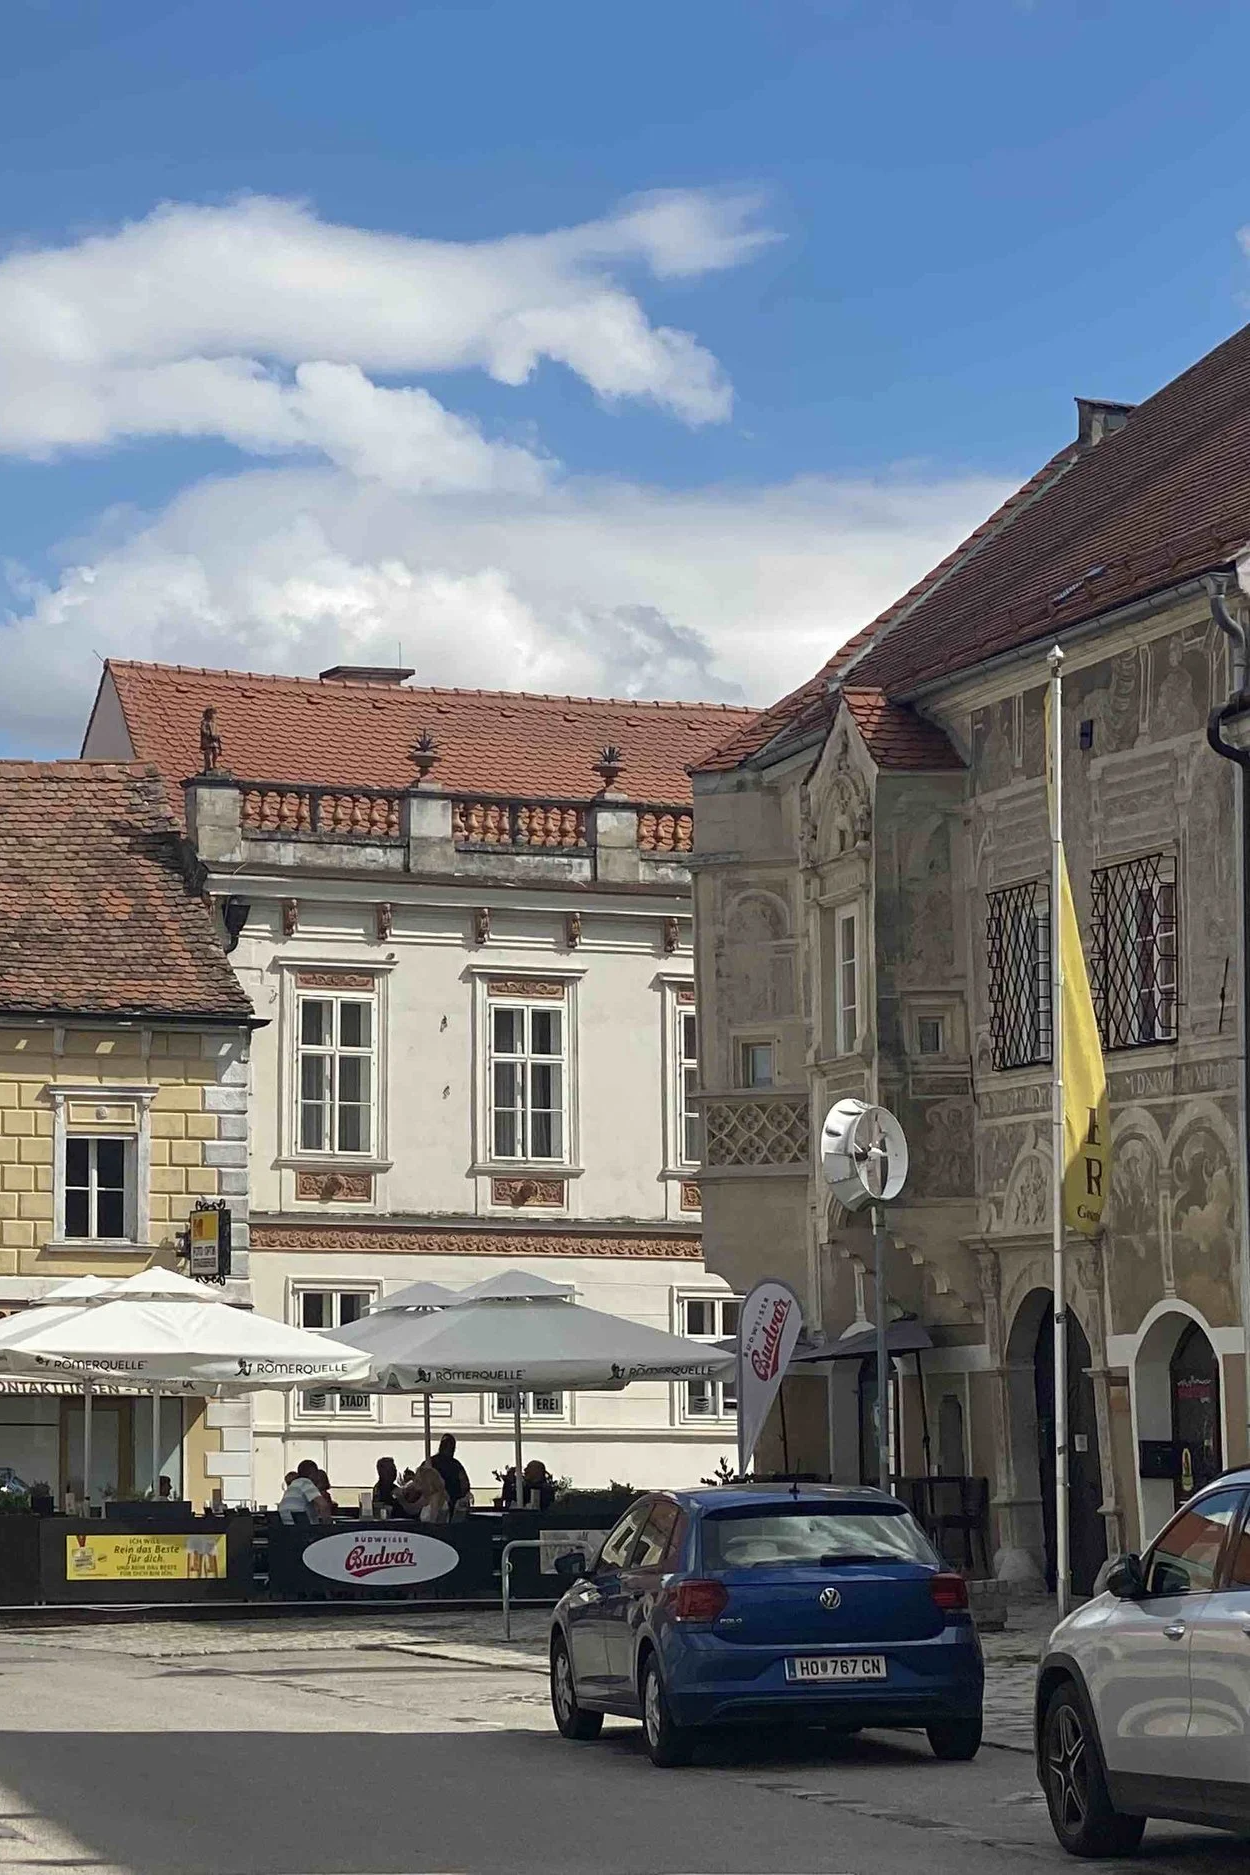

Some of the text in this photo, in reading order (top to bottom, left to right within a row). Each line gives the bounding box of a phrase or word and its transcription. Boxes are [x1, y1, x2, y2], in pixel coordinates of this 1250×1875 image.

[744, 1297, 769, 1358] BUDWEISER
[752, 1299, 791, 1381] Budvar
[340, 1394, 369, 1408] STADT
[114, 1545, 180, 1553] Rein das Beste
[127, 1554, 141, 1564] für
[345, 1545, 417, 1577] Budvar
[800, 1660, 819, 1676] HO
[830, 1659, 857, 1675] 767
[862, 1658, 881, 1674] CN
